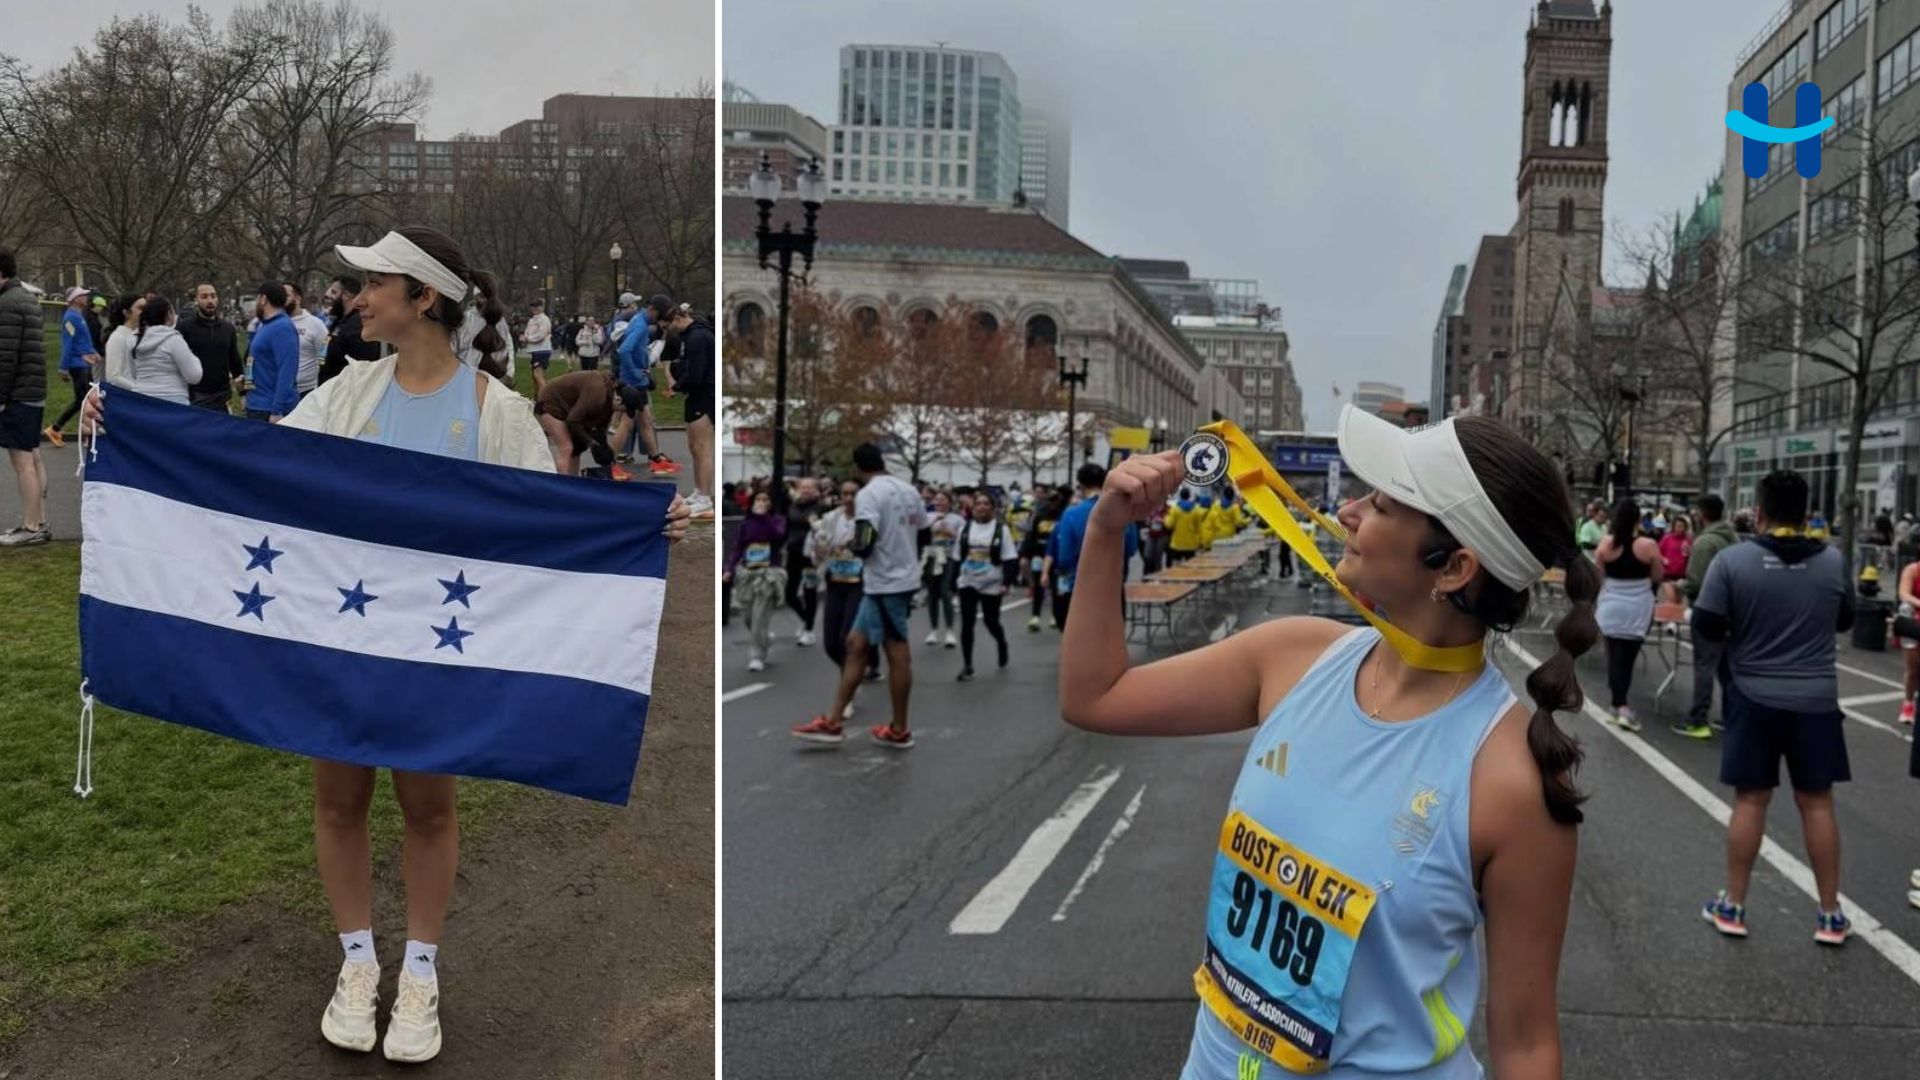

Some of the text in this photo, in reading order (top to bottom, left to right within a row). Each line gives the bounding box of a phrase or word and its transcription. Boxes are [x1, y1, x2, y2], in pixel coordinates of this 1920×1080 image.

[1316, 876, 1356, 920] 5K
[1227, 871, 1325, 986] 9169
[1226, 975, 1260, 1011] ATHLETIC
[1258, 1000, 1316, 1047] ASSOCIATION
[1244, 1022, 1276, 1055] 9169
